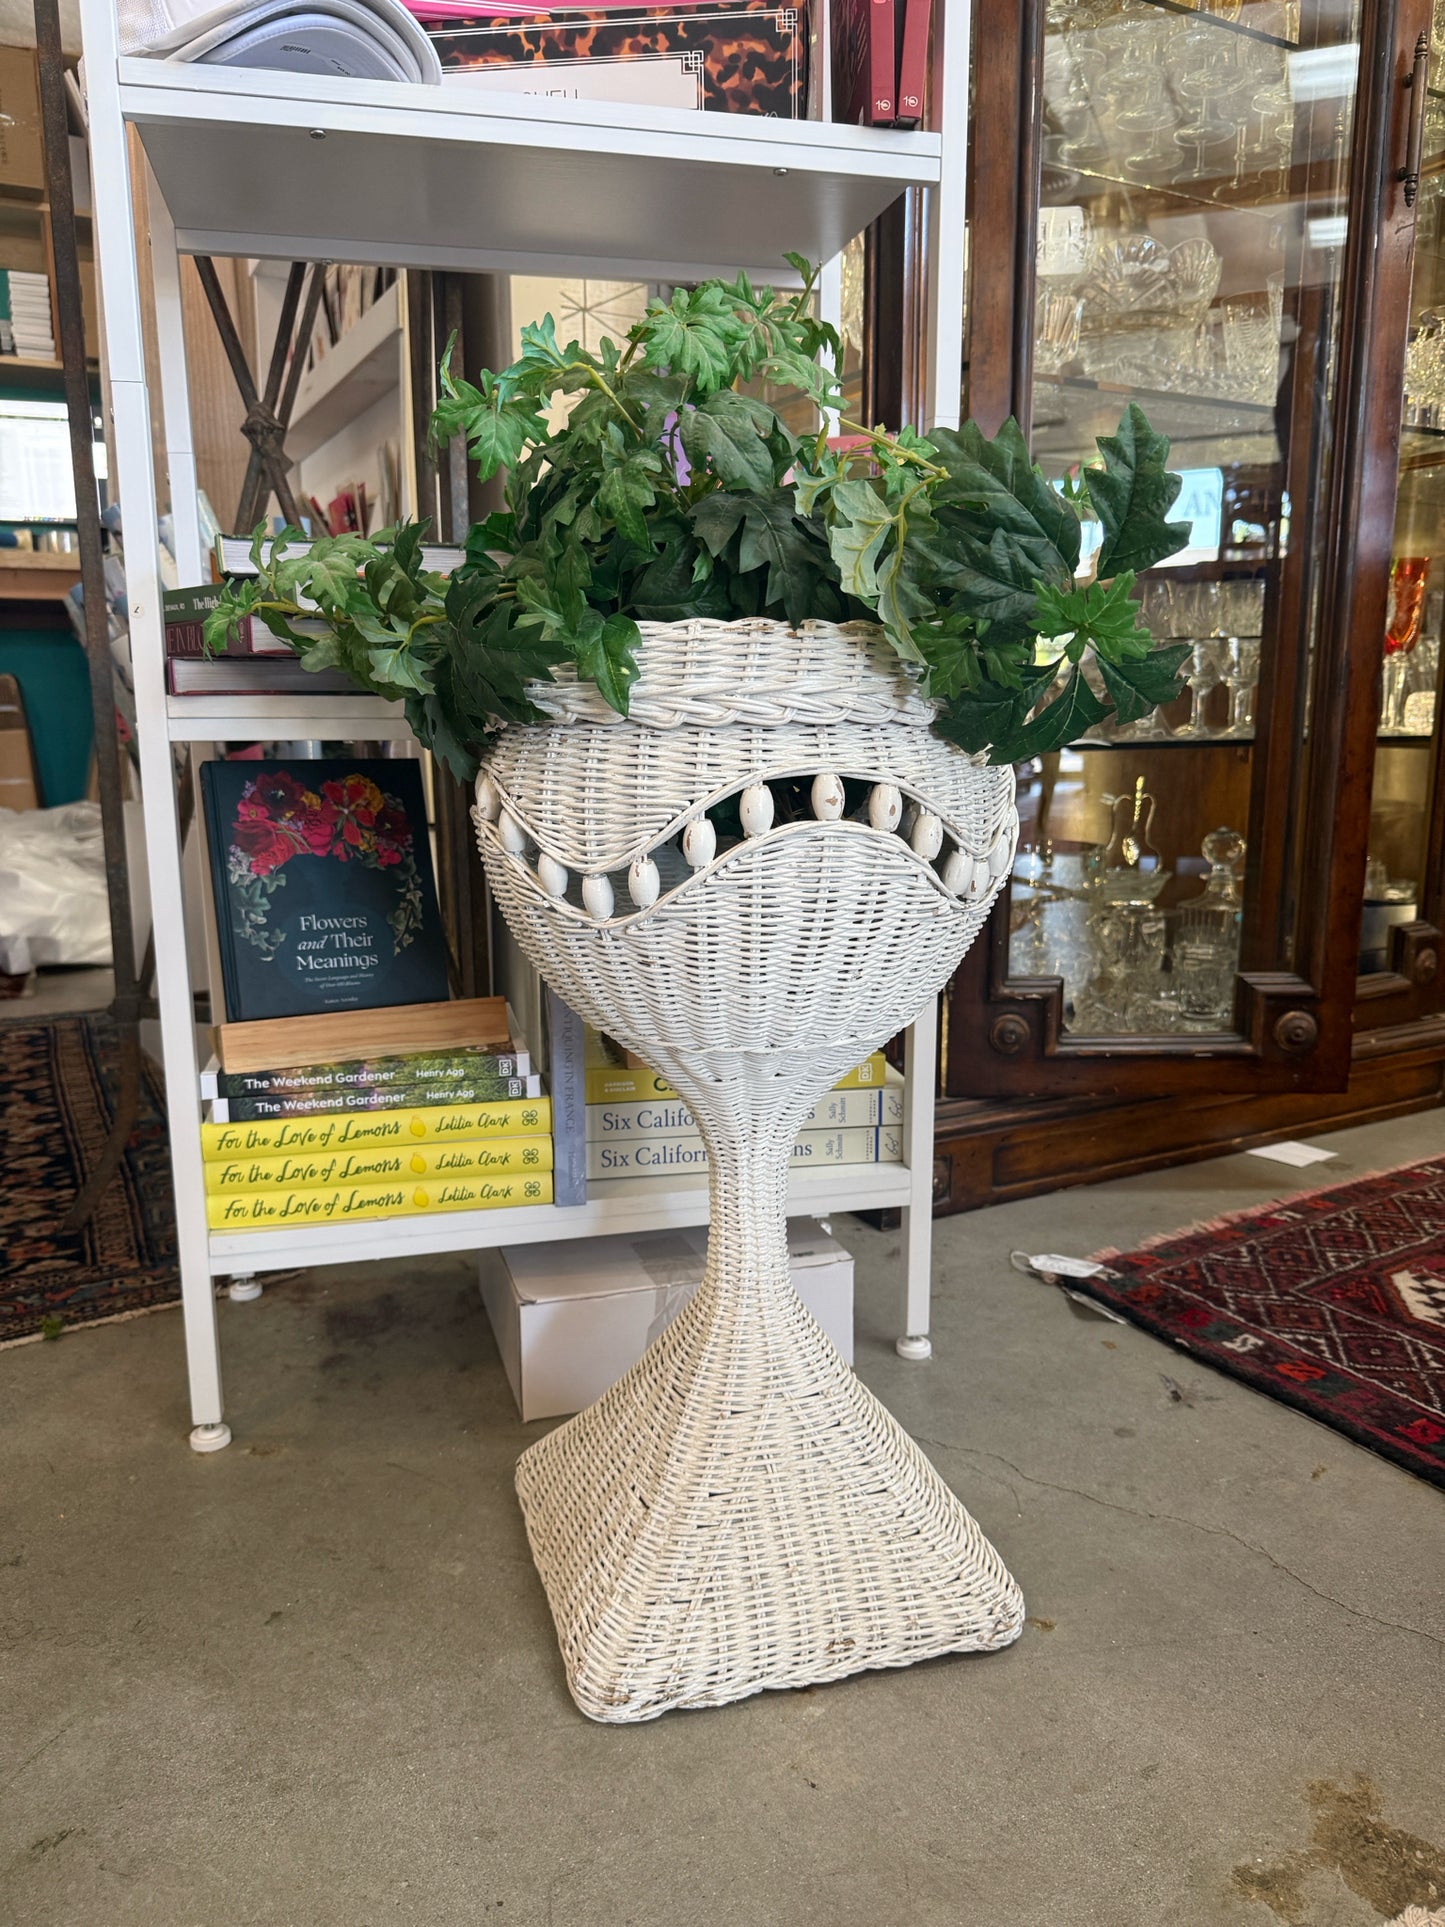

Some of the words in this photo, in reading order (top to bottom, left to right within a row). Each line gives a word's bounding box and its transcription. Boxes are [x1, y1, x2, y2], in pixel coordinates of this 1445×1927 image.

[300, 914, 367, 931] Flowers
[298, 935, 328, 951] and
[331, 932, 373, 948] Their
[296, 953, 379, 971] Meanings
[244, 1078, 270, 1089] The
[273, 1074, 332, 1087] Weekend
[335, 1070, 395, 1083] Gardener
[416, 1069, 443, 1079] Henry
[445, 1067, 465, 1079] Agg
[256, 1102, 281, 1113] The
[284, 1096, 342, 1110] Weekend
[346, 1092, 405, 1106] Gardener
[427, 1091, 454, 1101] Henry
[456, 1089, 475, 1100] Agg
[564, 1087, 576, 1134] FRANCE
[828, 1103, 838, 1121] Sally
[602, 1112, 632, 1131] Six
[637, 1108, 697, 1129] Califo
[217, 1130, 242, 1151] For
[246, 1129, 271, 1148] the
[274, 1125, 317, 1148] Love
[320, 1123, 335, 1147] of
[339, 1119, 401, 1142] Lemons
[435, 1116, 473, 1133] Letitia
[477, 1112, 511, 1128] Clark
[601, 1149, 629, 1168] Six
[825, 1139, 834, 1157] Sally
[220, 1165, 245, 1185] For
[250, 1163, 274, 1183] the
[276, 1160, 318, 1182] Love
[321, 1158, 336, 1181] of
[340, 1156, 402, 1178] Lemons
[435, 1153, 473, 1170] Letitia
[478, 1150, 512, 1165] Clark
[225, 1200, 248, 1219] For
[252, 1199, 276, 1218] the
[279, 1194, 322, 1217] Love
[325, 1192, 340, 1215] of
[342, 1190, 405, 1212] Lemons
[438, 1187, 475, 1204] Letitia
[480, 1184, 513, 1199] Clark
